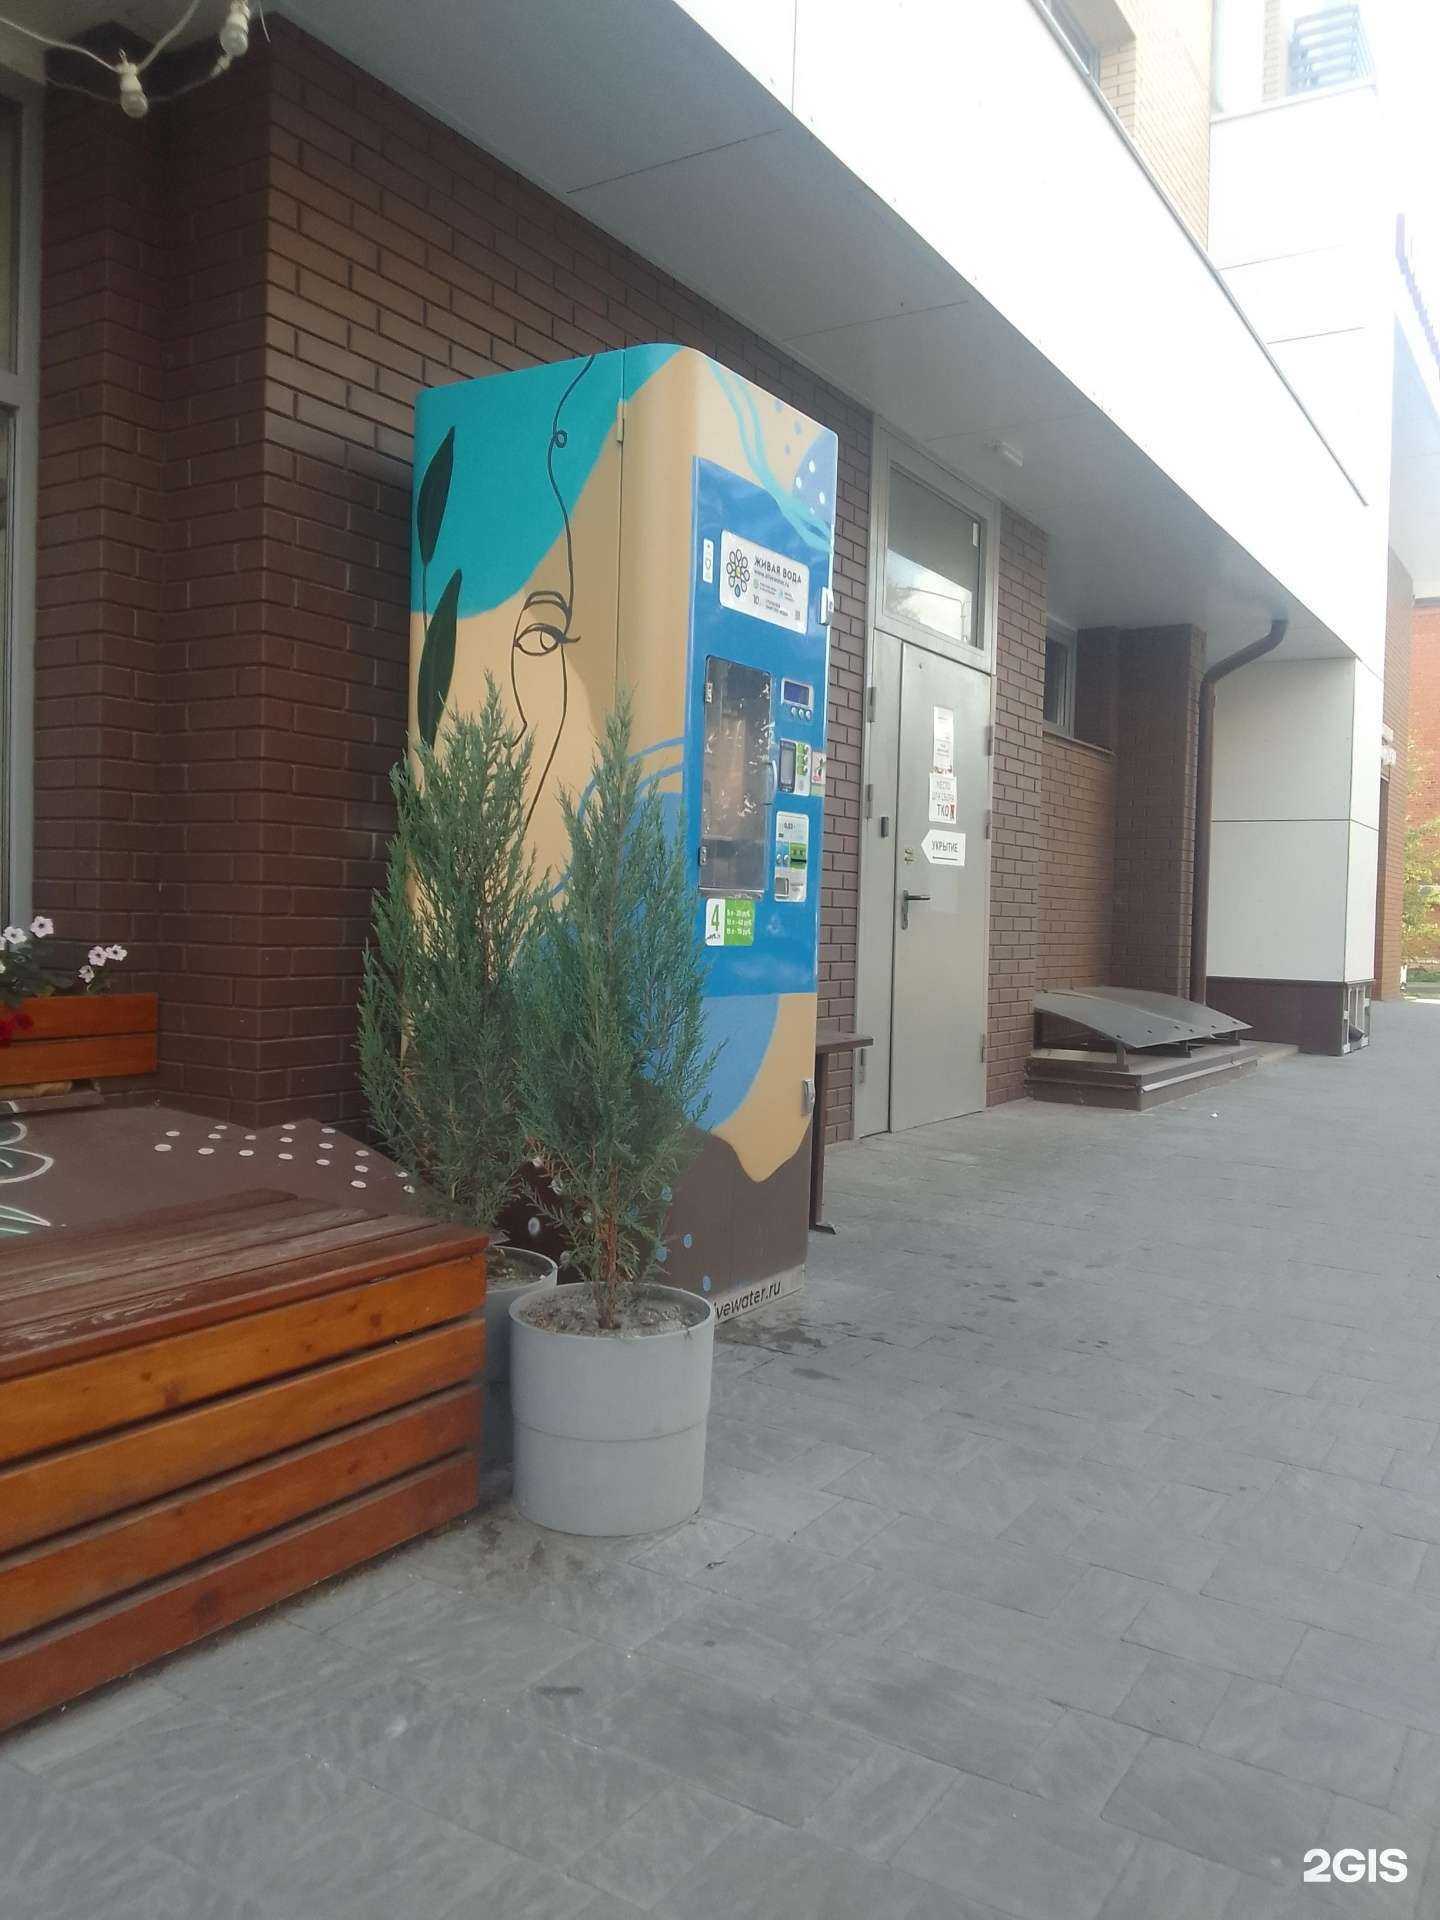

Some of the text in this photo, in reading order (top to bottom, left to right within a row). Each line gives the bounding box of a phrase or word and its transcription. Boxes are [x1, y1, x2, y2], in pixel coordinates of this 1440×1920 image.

[754, 555, 802, 583] ЖИВАЯ ВОДА
[936, 803, 949, 817] ТКО
[931, 840, 959, 853] УКРЫТИЕ
[711, 903, 720, 931] 4
